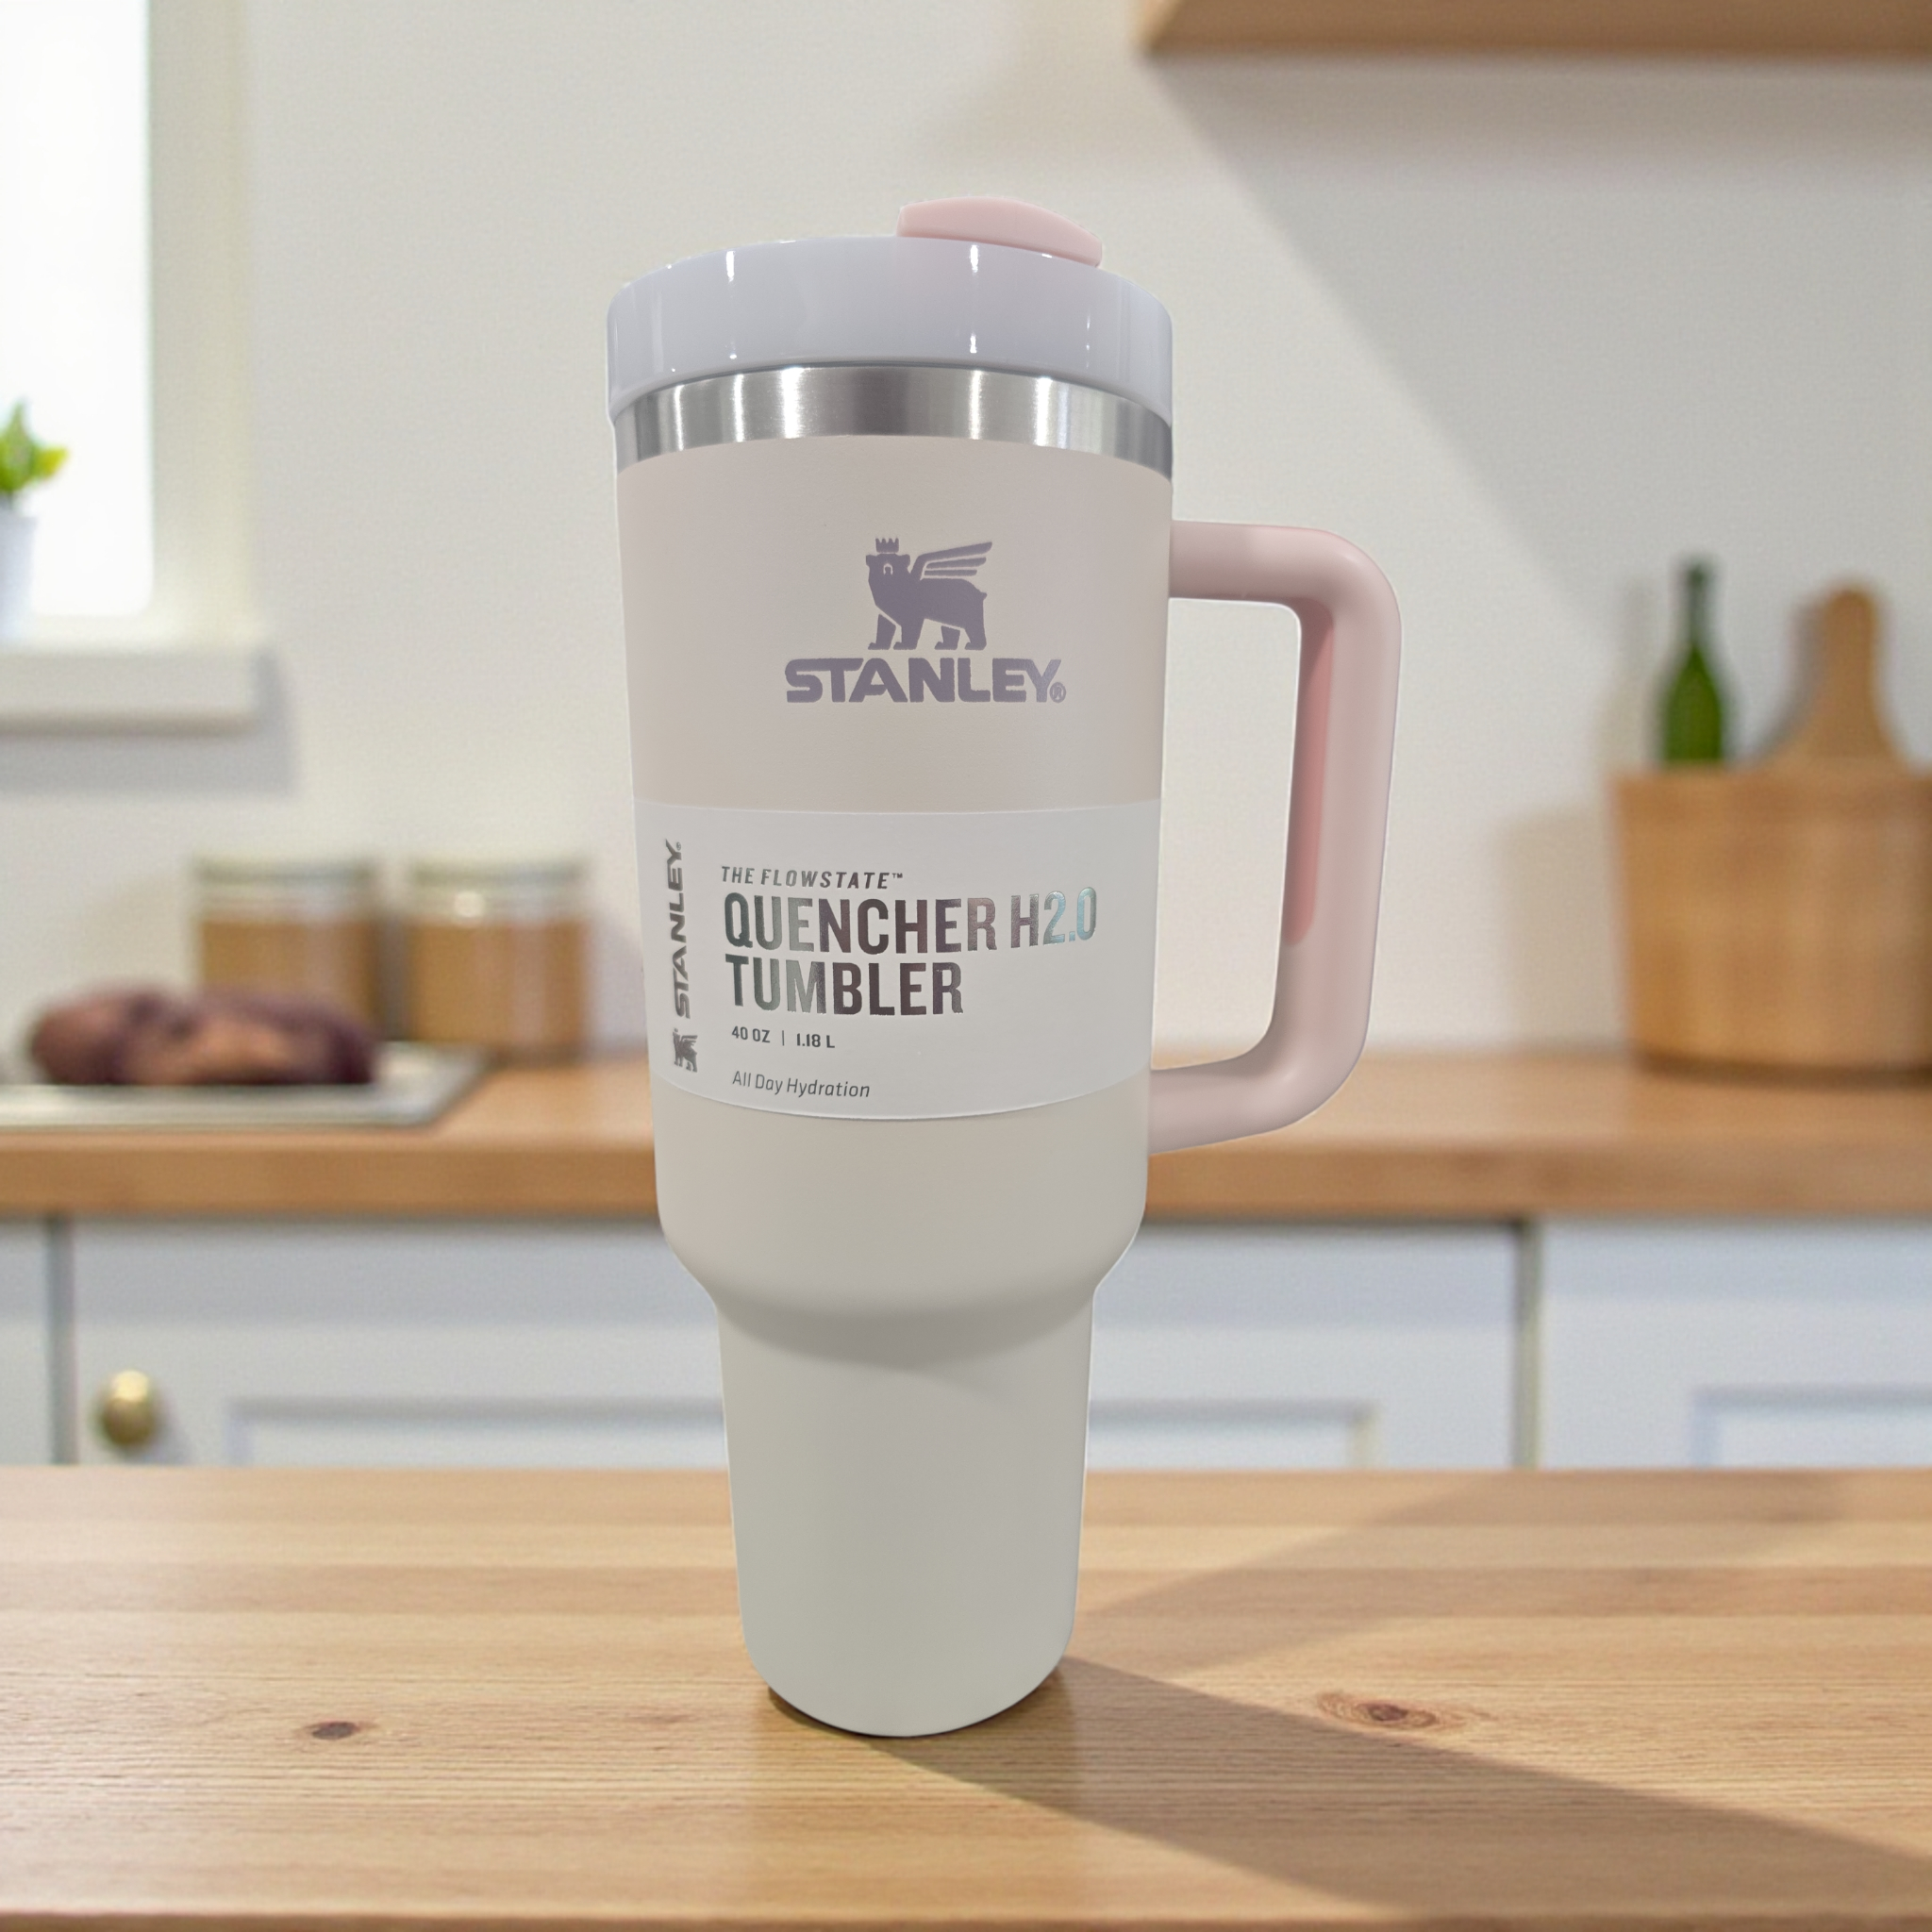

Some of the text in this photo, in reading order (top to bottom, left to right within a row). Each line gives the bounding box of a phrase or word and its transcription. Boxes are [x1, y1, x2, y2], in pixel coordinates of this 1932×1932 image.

[721, 866, 755, 885] THE
[724, 887, 1097, 955] QUENCHER H2.0
[724, 954, 964, 1016] TUMBLER
[731, 1025, 749, 1041] 40
[752, 1027, 771, 1043] OZ
[796, 1033, 822, 1048] 1.18
[825, 1034, 836, 1049] L
[732, 1071, 871, 1098] All Day Hydration
